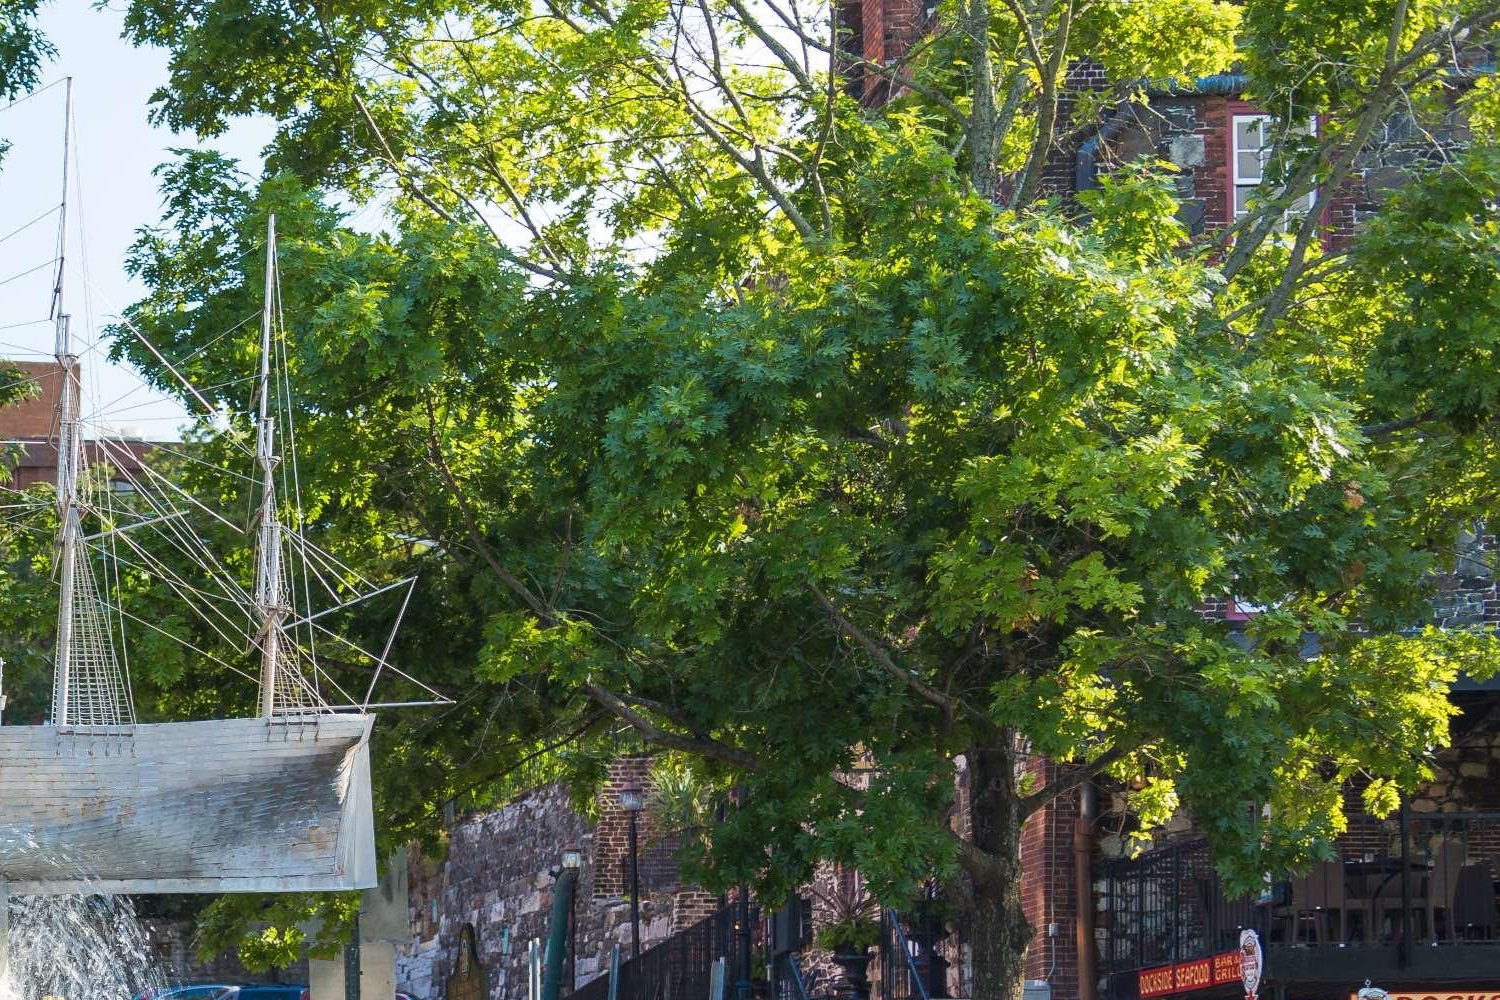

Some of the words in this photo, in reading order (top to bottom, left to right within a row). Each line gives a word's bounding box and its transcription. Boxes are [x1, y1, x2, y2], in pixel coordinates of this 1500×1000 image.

[1214, 955, 1233, 969] BAR
[1140, 969, 1173, 994] DOCKSIDE
[1175, 963, 1209, 988] SEAFOOD
